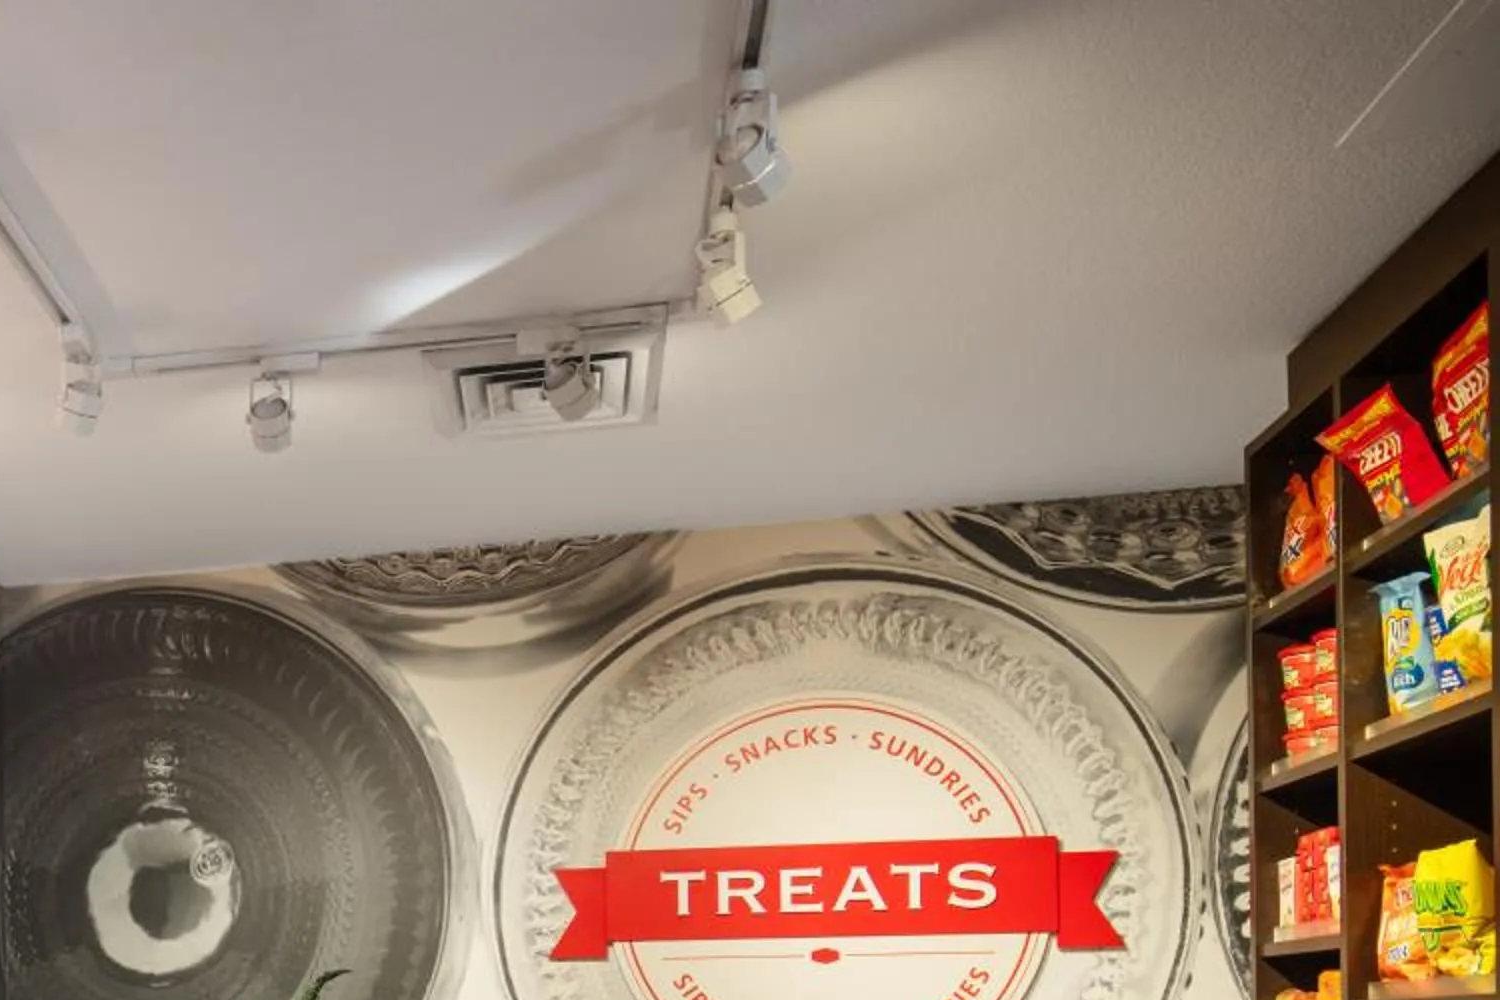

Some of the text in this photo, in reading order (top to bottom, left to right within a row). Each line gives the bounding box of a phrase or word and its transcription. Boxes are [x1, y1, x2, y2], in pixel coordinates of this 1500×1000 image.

[663, 725, 991, 835] SIPS SNACKS SUNDRIES
[658, 862, 999, 917] TREATS
